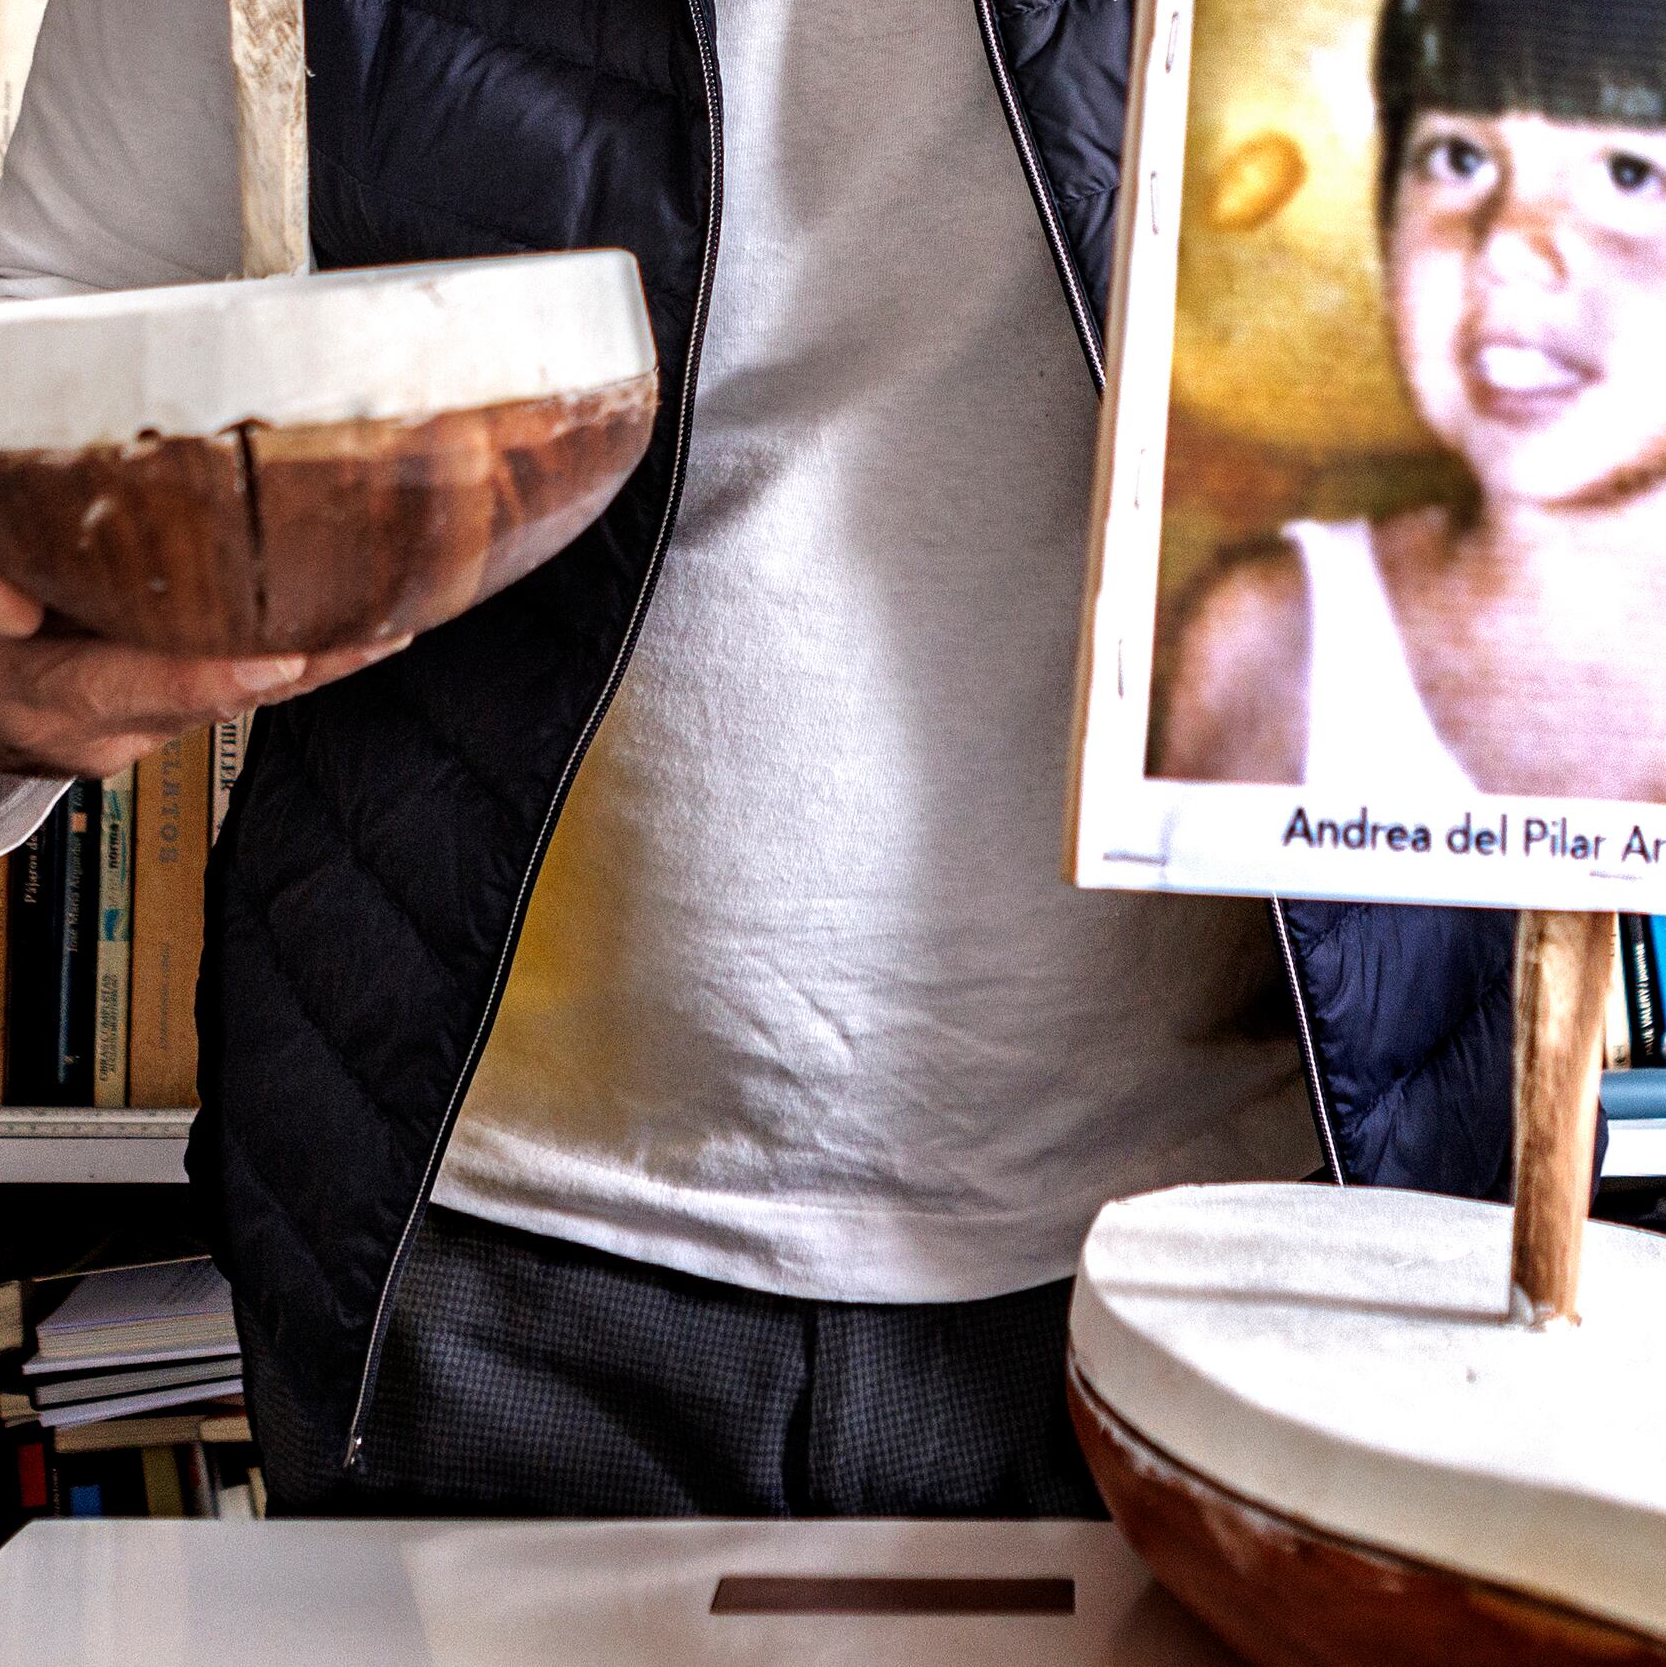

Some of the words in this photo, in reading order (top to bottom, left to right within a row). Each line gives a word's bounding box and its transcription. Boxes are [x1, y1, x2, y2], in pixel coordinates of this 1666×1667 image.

[1282, 805, 1434, 855] Andrea
[1446, 815, 1507, 857] del
[1523, 817, 1603, 862] Pilar
[23, 854, 40, 904] Pájaros
